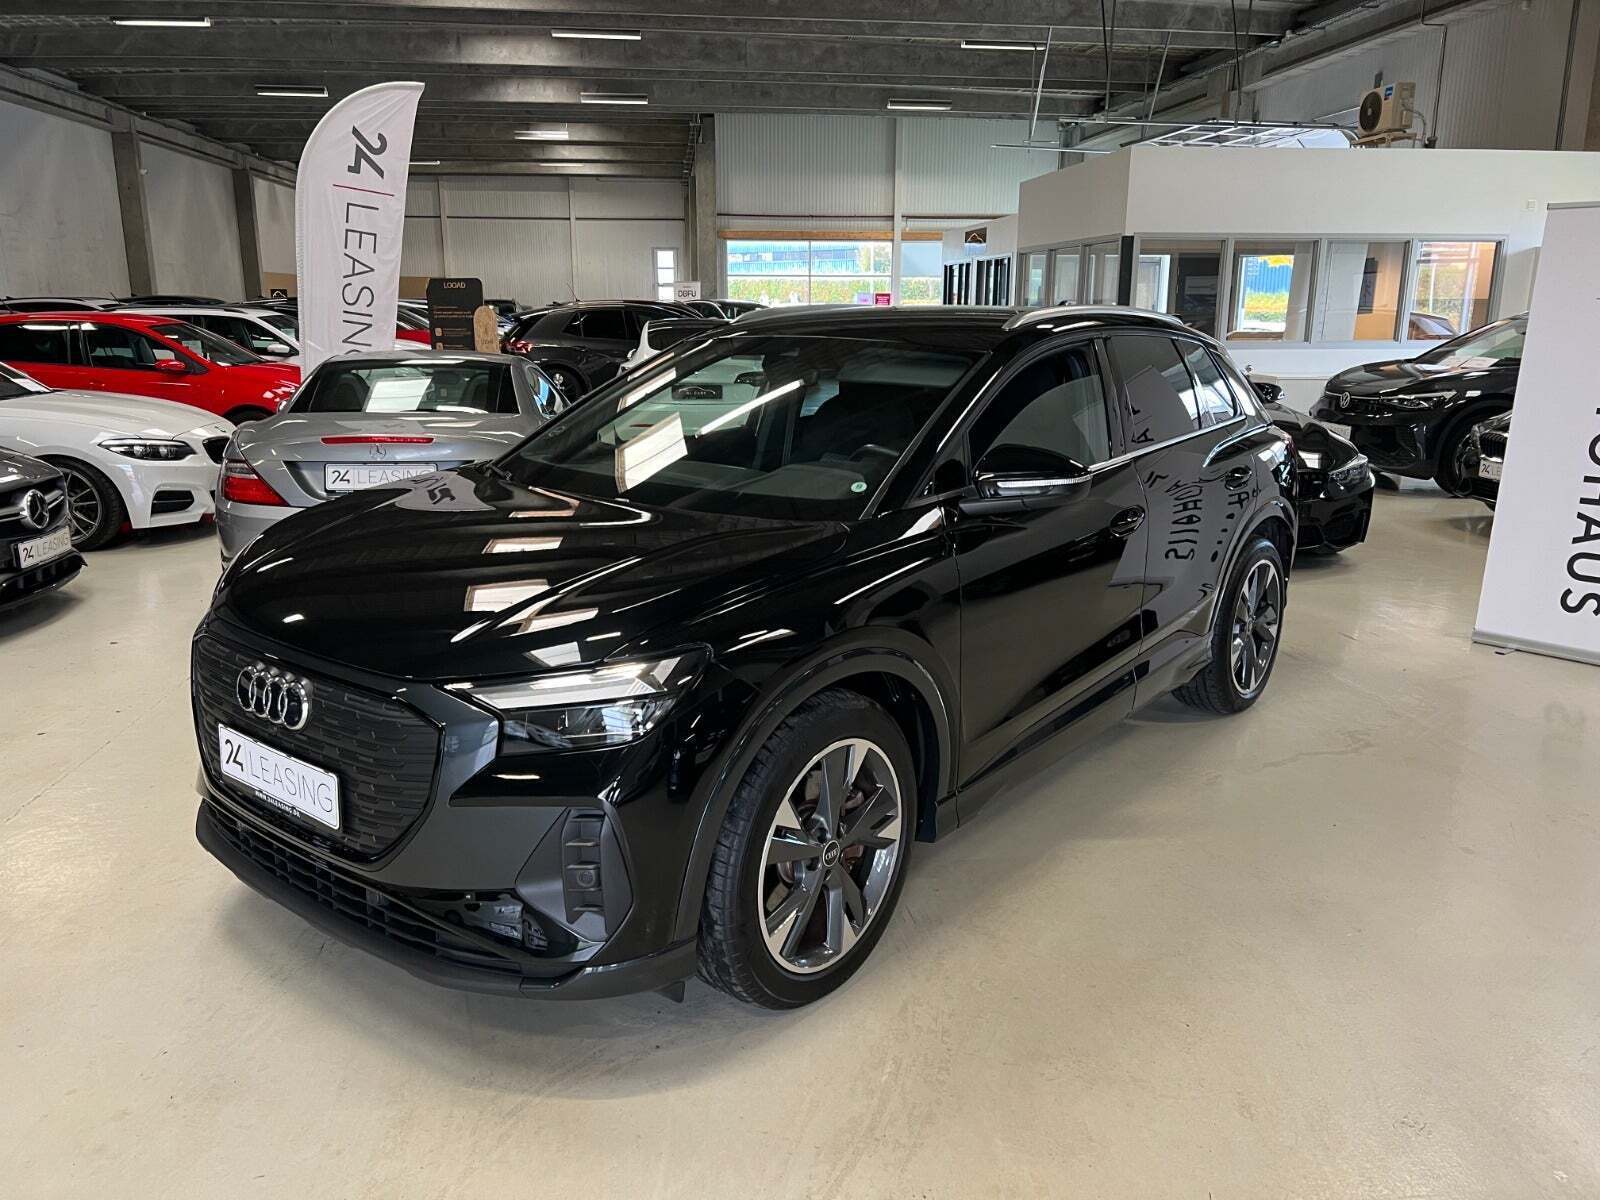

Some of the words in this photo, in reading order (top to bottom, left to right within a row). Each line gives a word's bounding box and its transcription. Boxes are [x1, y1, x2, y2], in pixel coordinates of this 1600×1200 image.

[347, 125, 388, 180] 24
[331, 469, 350, 484] 24
[22, 544, 34, 562] 24
[37, 532, 70, 557] LEASING
[224, 738, 244, 773] 24
[248, 750, 333, 813] LEASING
